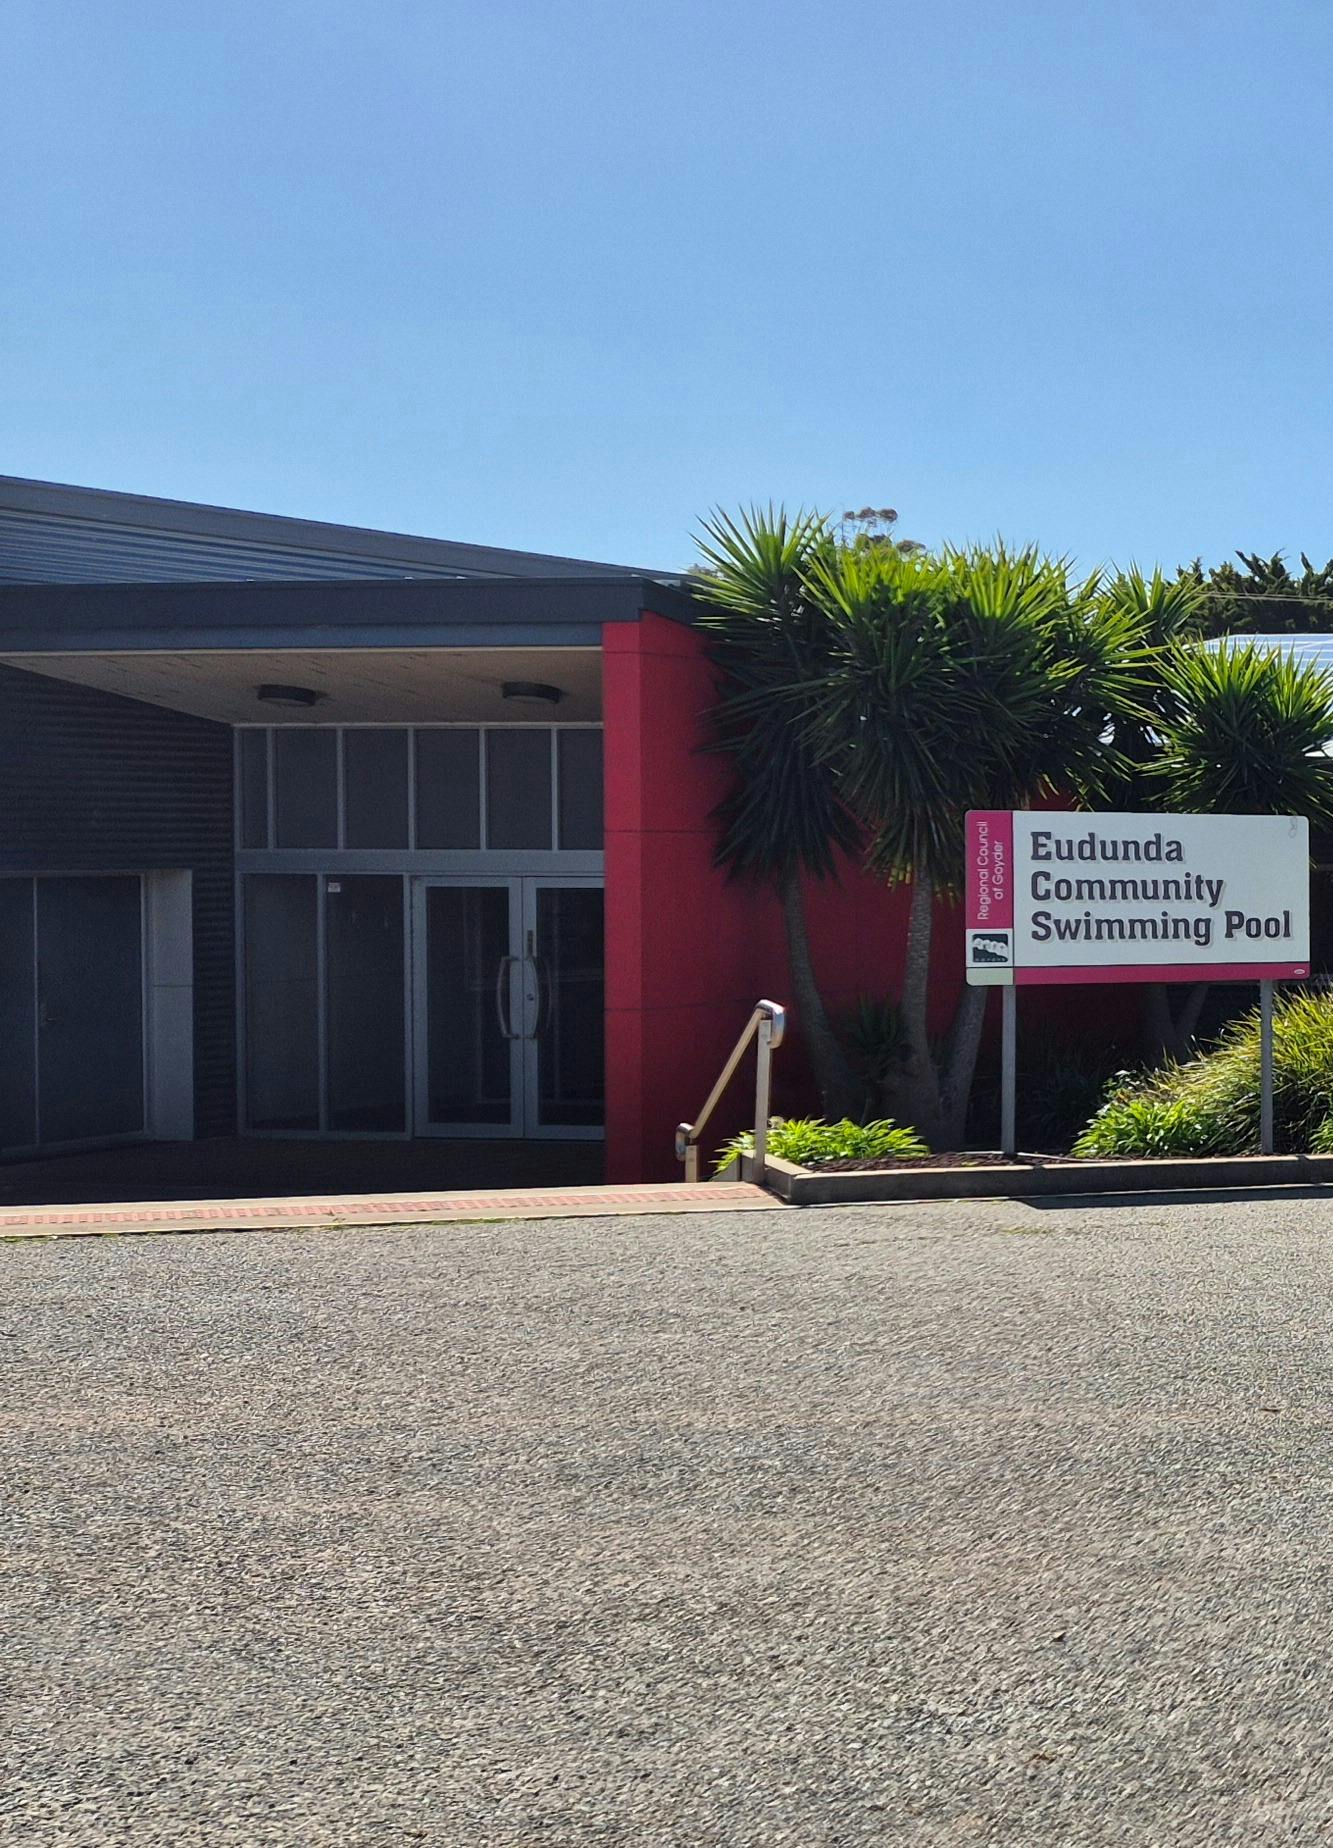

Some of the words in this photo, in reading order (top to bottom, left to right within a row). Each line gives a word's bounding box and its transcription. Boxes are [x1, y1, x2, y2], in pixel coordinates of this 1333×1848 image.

[976, 821, 988, 866] Council
[1030, 832, 1183, 862] Eudunda
[992, 841, 1005, 884] Goyder
[977, 869, 991, 919] Regional
[993, 887, 1003, 900] of
[1031, 871, 1224, 907] Community
[1031, 911, 1211, 946] Swimming
[1225, 911, 1291, 938] Pool
